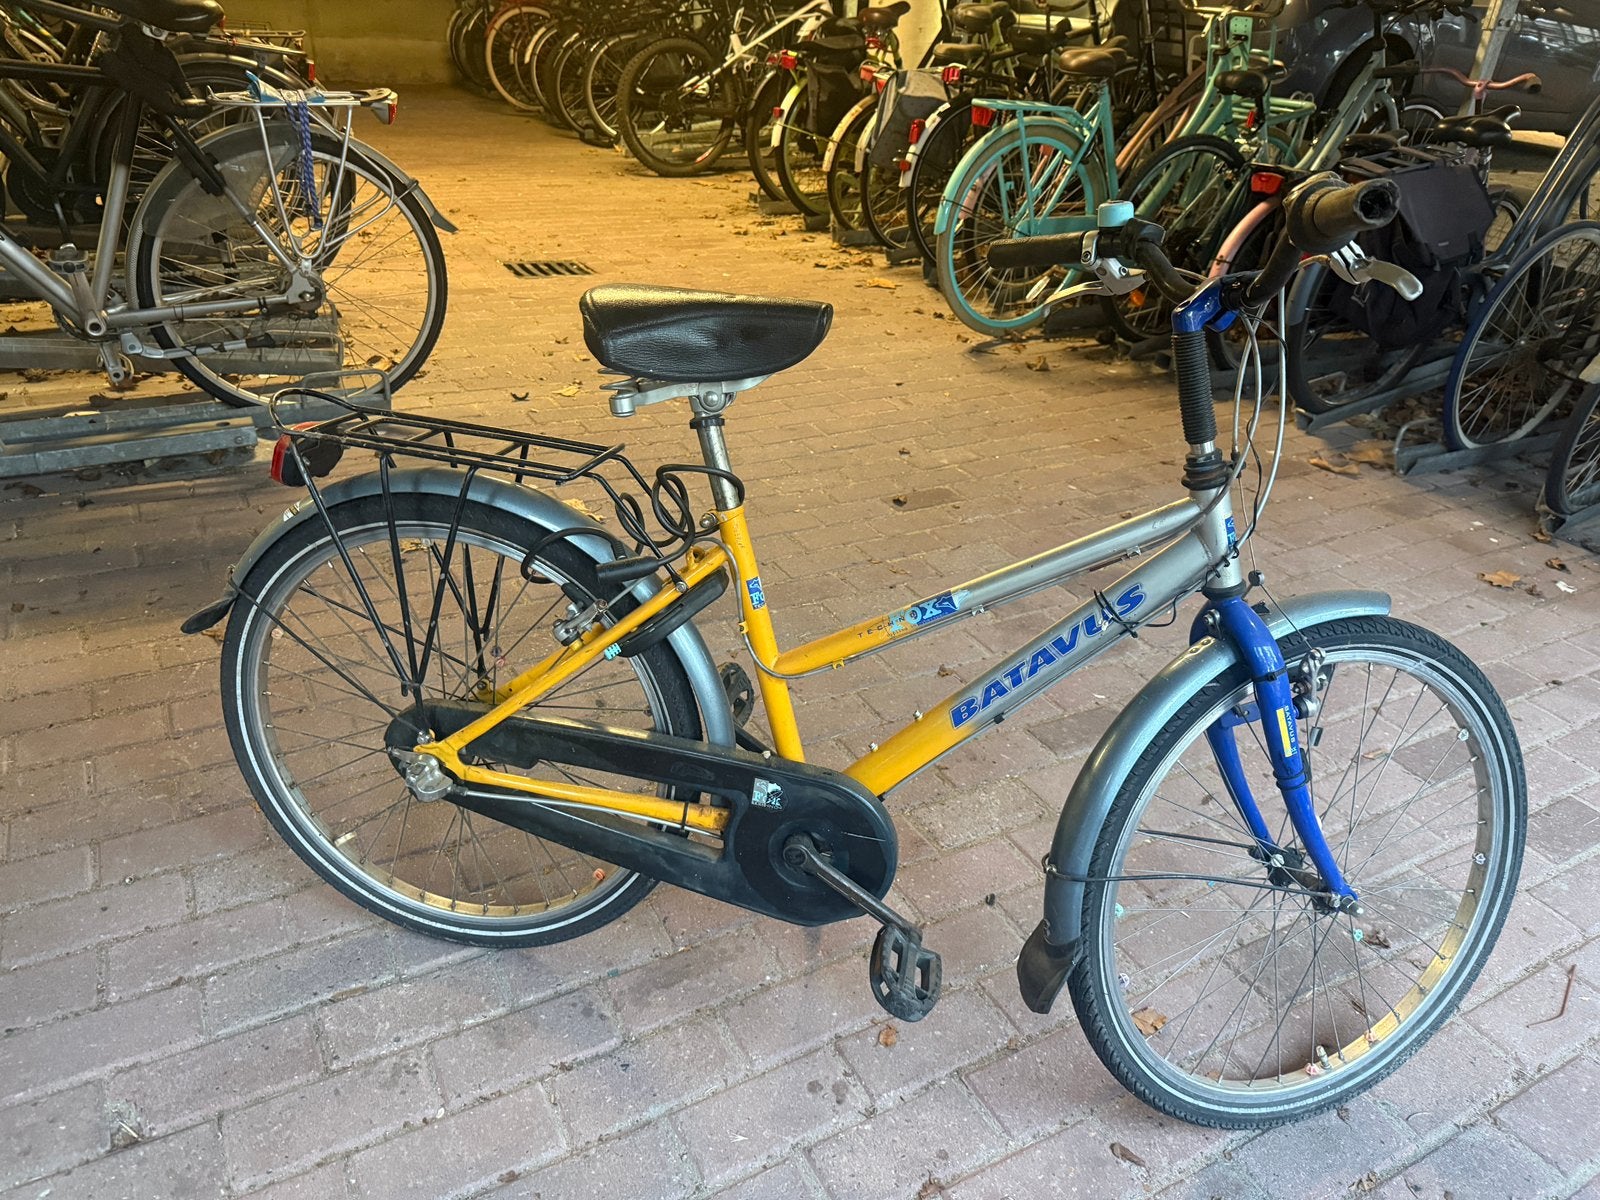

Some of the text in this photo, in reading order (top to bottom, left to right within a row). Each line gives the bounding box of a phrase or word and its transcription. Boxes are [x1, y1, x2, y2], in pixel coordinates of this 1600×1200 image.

[888, 599, 942, 633] FOX
[950, 584, 1145, 729] BATAVUS
[1284, 705, 1295, 743] BATAVUS
